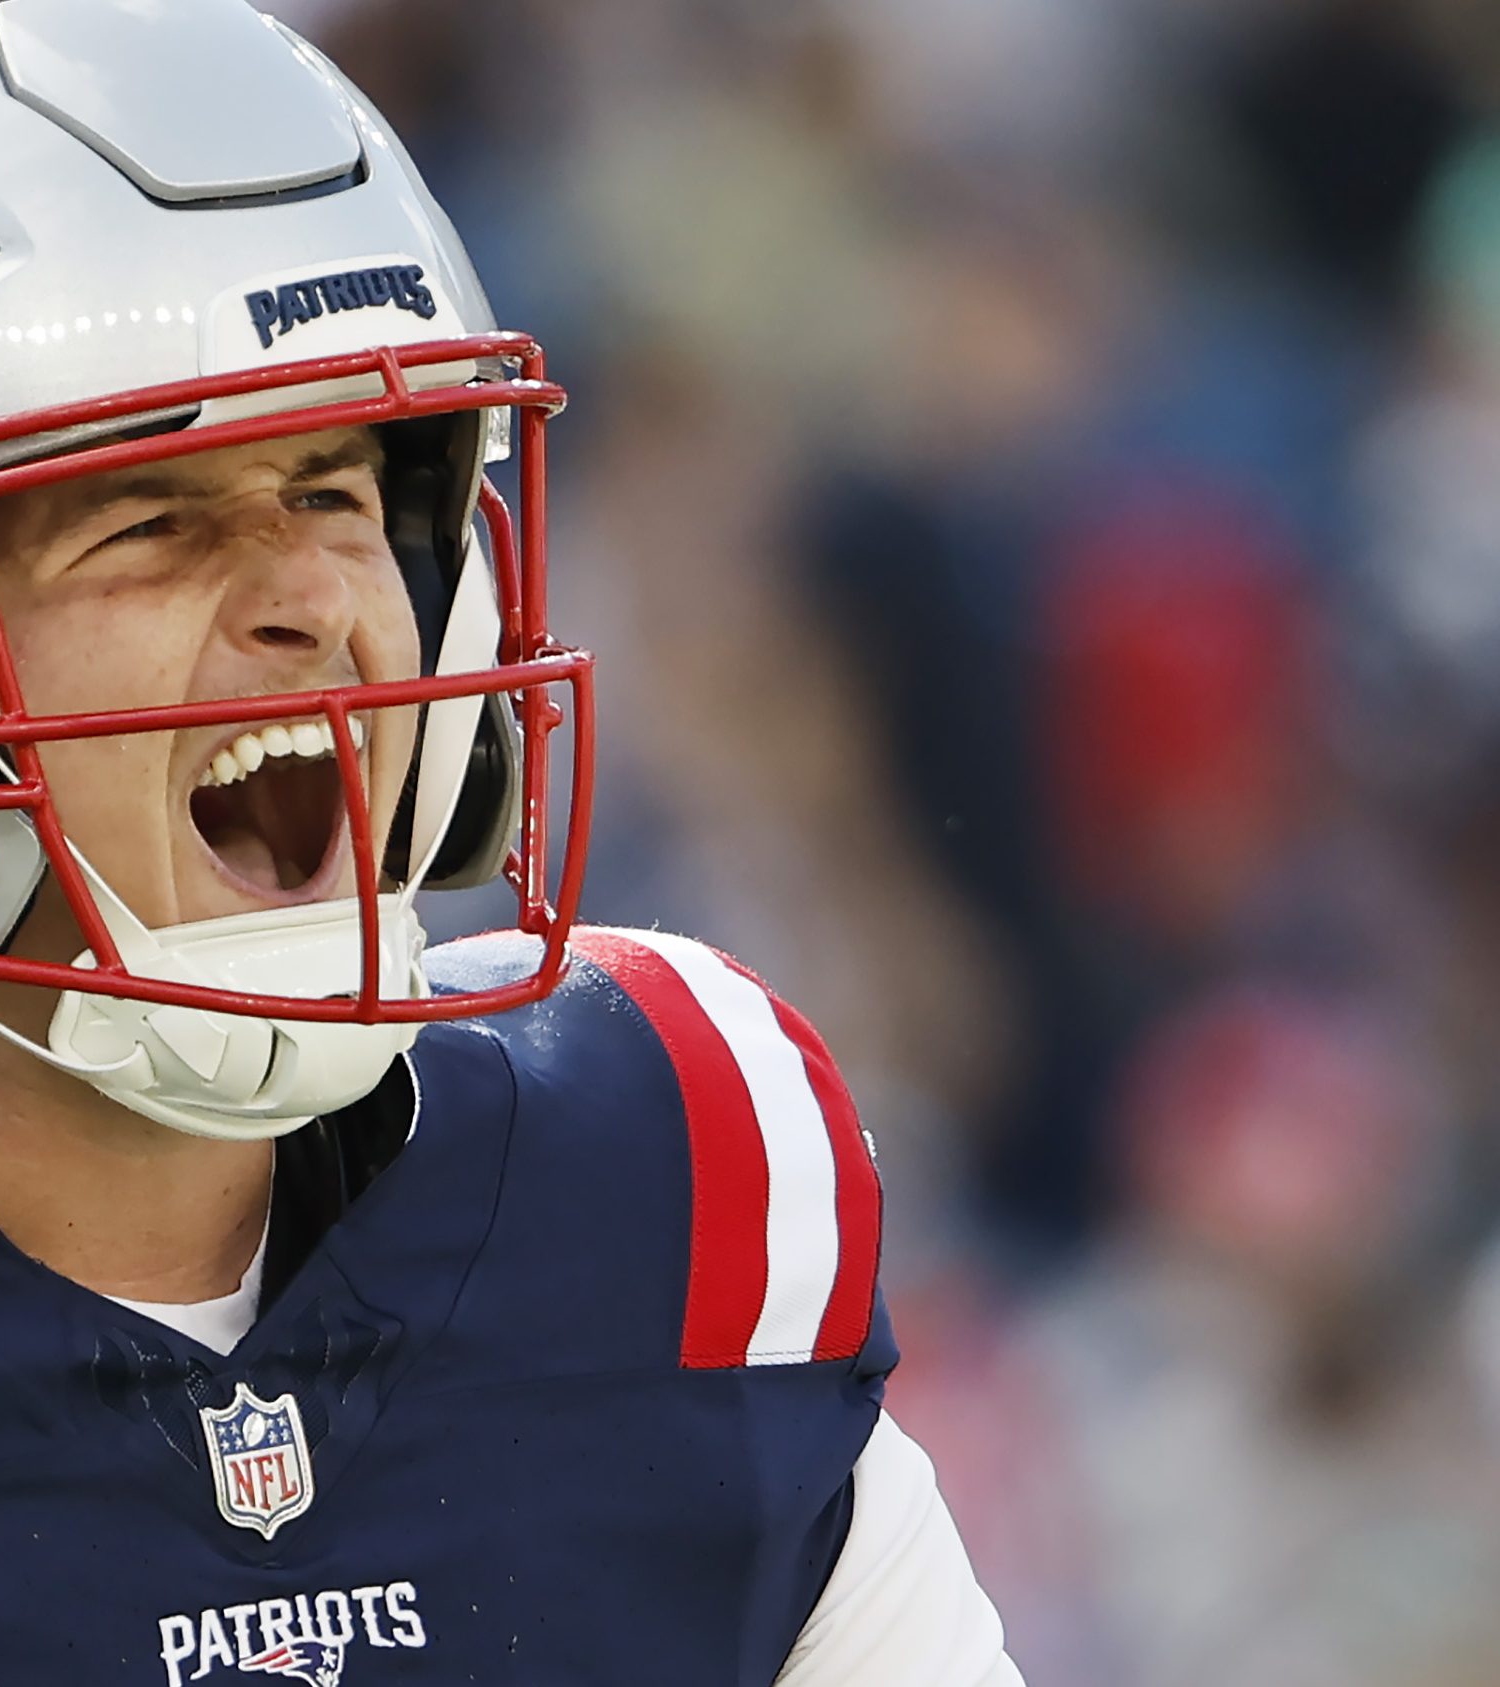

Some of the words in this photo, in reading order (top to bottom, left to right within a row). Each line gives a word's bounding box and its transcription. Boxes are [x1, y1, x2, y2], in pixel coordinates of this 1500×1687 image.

[244, 265, 436, 348] PATRIOTS
[230, 1452, 298, 1511] NFL
[159, 1582, 426, 1687] PATRIOTS
